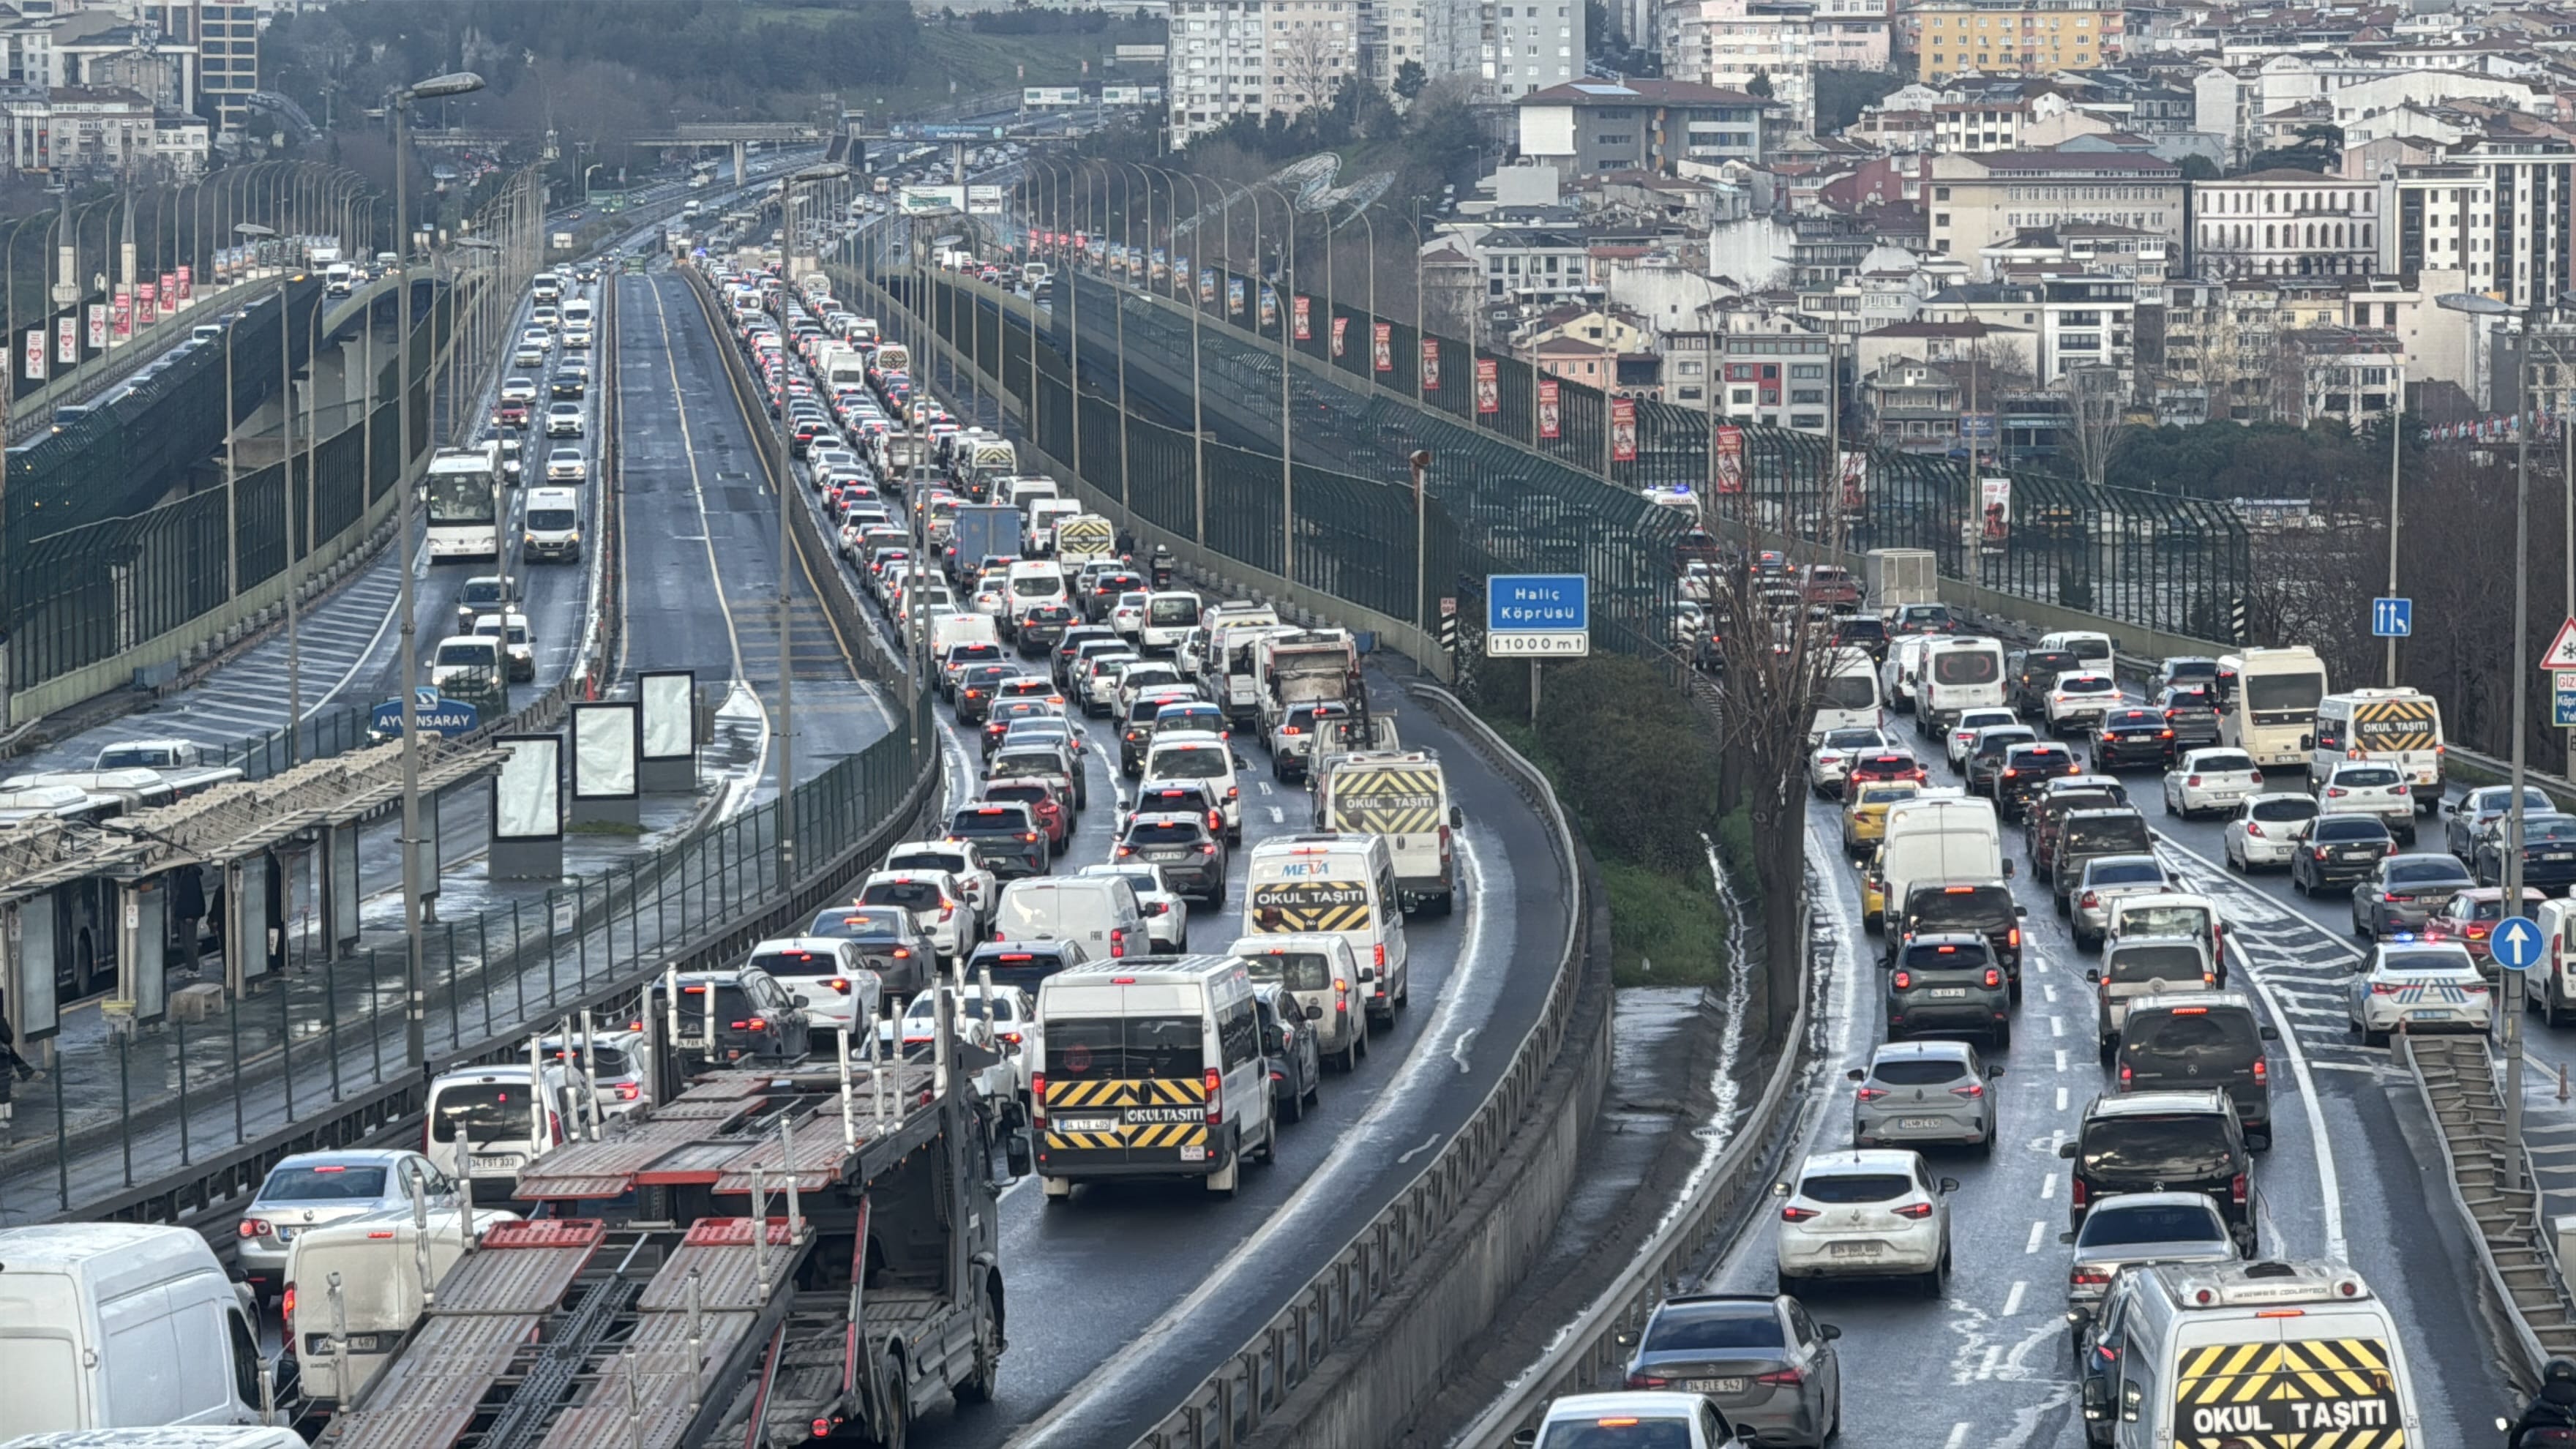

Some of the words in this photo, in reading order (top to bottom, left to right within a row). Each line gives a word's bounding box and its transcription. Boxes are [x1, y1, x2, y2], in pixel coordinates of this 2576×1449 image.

[1514, 588, 1560, 602] Haliç
[1501, 606, 1575, 623] Köprüsü
[1505, 638, 1551, 650] 1000
[1557, 640, 1572, 650] m
[2558, 674, 2576, 688] GİZ
[2557, 694, 2576, 709] Köpr
[379, 714, 470, 728] AYVNSARAY
[2363, 722, 2392, 733] OKUL
[2395, 721, 2429, 733] TAŞITI
[1346, 798, 1382, 809] OKUL
[1393, 796, 1434, 809] TAŞITI
[1257, 891, 1306, 905] OKUL
[1311, 889, 1365, 906] TAŞITI
[1064, 1120, 1074, 1131] 34
[471, 1159, 482, 1168] 34
[1688, 1381, 1700, 1391] 34
[1702, 1380, 1720, 1390] FLE
[1723, 1379, 1741, 1390] 542
[2193, 1404, 2274, 1434] OKUL
[2291, 1399, 2389, 1433] TAŞITI
